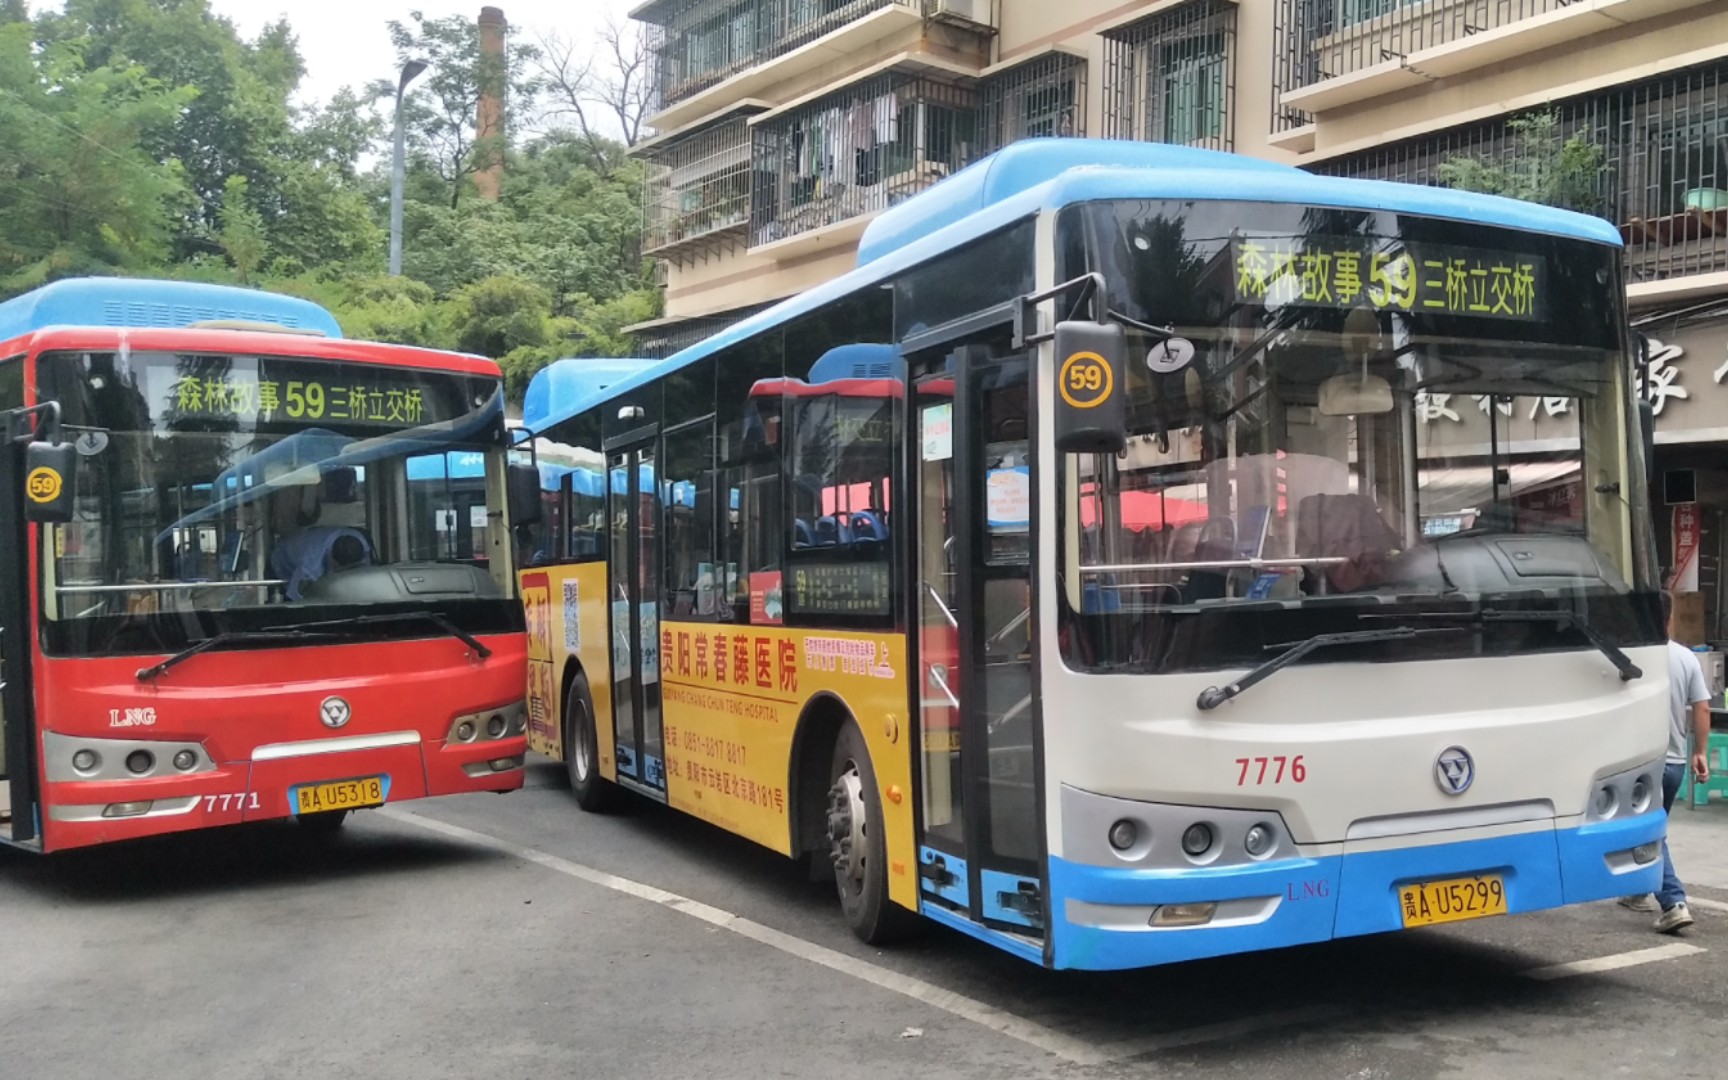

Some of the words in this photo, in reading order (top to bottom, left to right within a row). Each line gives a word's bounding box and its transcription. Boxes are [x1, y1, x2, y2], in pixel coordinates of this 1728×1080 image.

[1237, 244, 1362, 304] 森林故事
[1369, 252, 1418, 308] 59
[1424, 257, 1536, 316] 三桥立交桥
[1070, 365, 1102, 390] 59
[177, 374, 281, 415] 森林故事
[286, 381, 325, 419] 59
[330, 385, 423, 423] 三桥立交桥
[31, 477, 55, 494] 59
[662, 628, 798, 694] 贵阳常春藤医院
[109, 708, 156, 728] LNG
[686, 691, 706, 709] CHANG
[707, 695, 725, 711] CHUN
[725, 698, 743, 716] TENG
[744, 702, 779, 723] HOSPITAL
[1235, 755, 1307, 786] 7776
[204, 792, 260, 813] 7771
[1287, 880, 1330, 901] LNG
